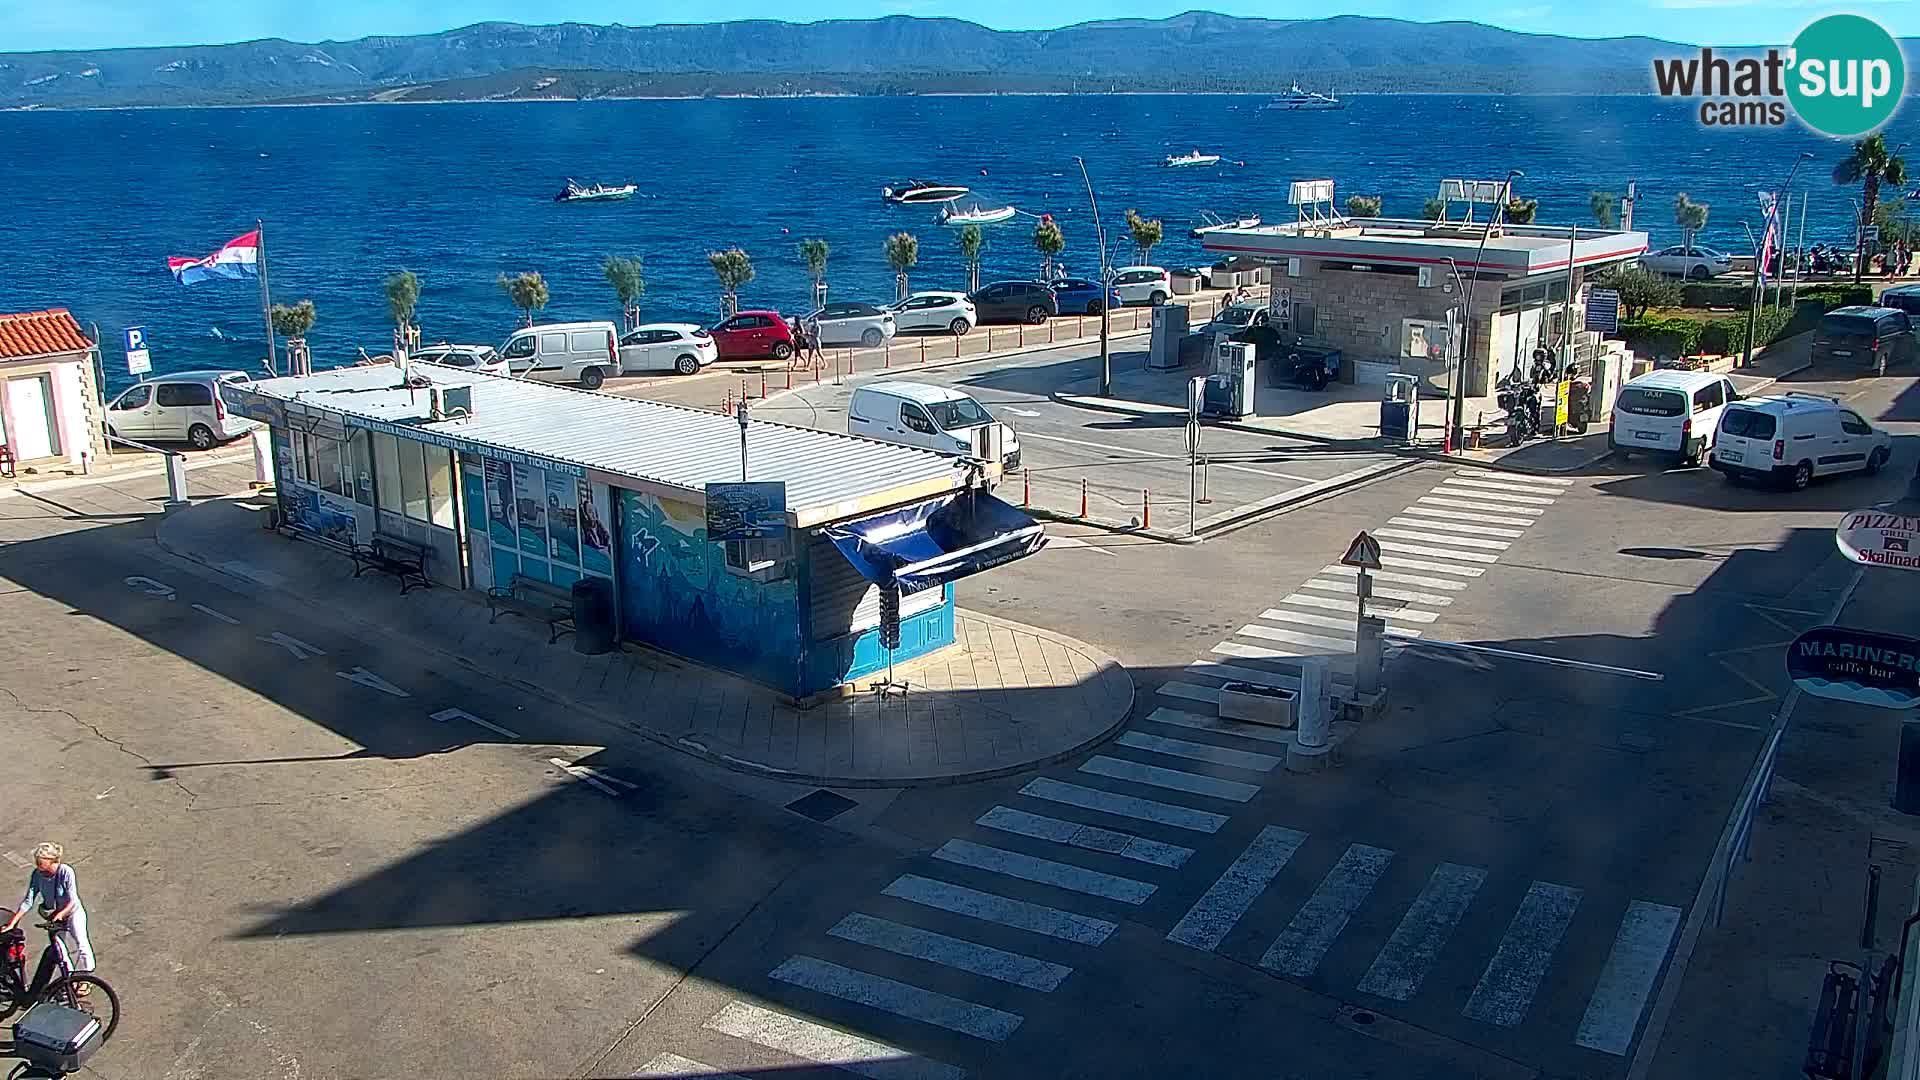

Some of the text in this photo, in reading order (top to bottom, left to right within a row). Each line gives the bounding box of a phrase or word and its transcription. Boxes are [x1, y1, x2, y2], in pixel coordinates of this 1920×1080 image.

[128, 330, 142, 349] P
[493, 449, 526, 464] STATION
[527, 457, 554, 470] TICKET
[556, 463, 582, 476] OFFICE
[1870, 665, 1896, 679] bar
